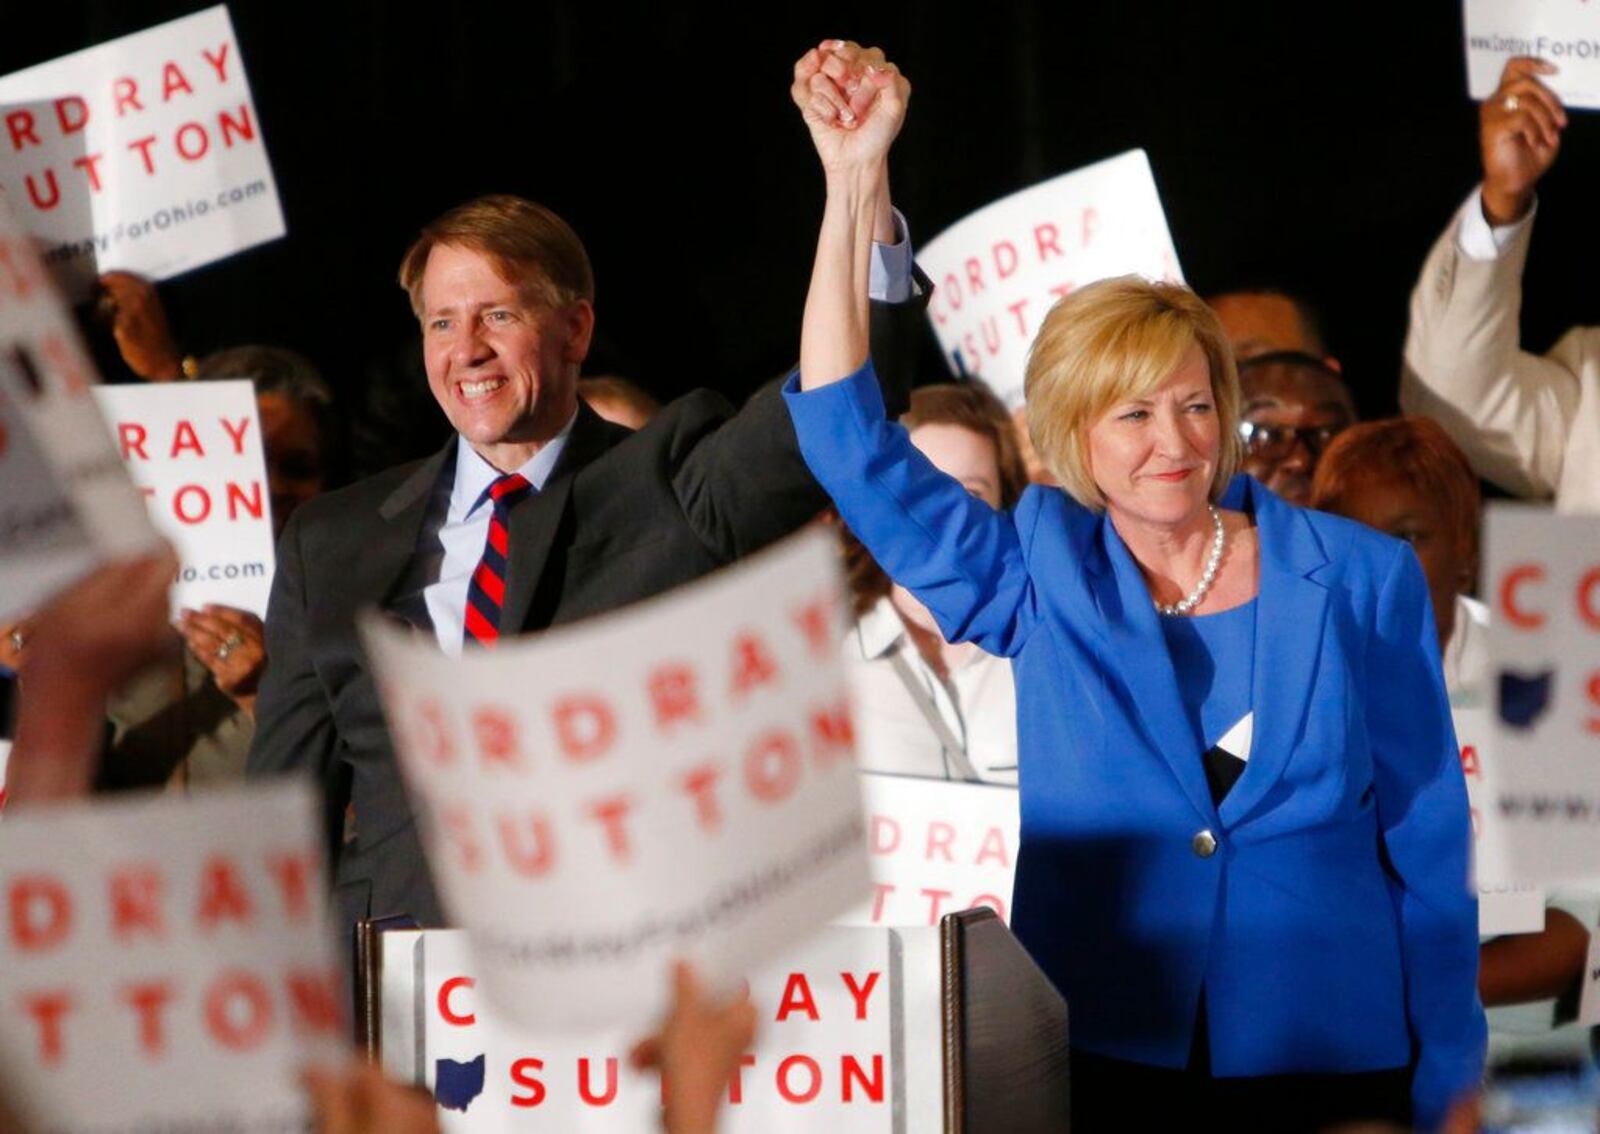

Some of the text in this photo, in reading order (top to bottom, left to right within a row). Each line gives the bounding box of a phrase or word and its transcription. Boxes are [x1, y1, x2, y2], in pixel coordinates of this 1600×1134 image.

[0, 104, 256, 212] UTTON
[117, 416, 251, 461] RAY
[138, 481, 264, 526] ON
[870, 814, 1010, 870] DRA
[510, 1053, 884, 1106] SUTON
